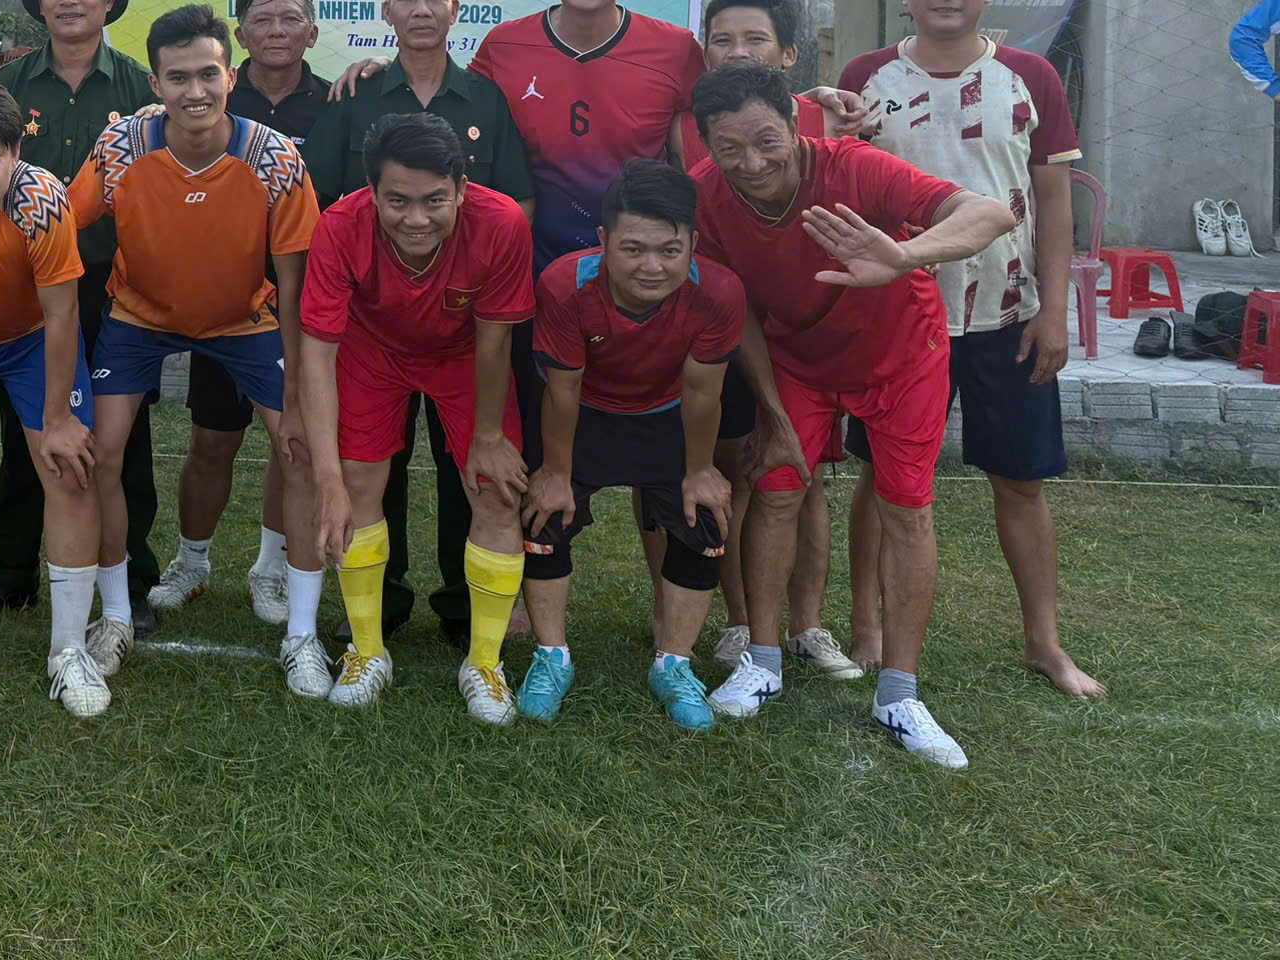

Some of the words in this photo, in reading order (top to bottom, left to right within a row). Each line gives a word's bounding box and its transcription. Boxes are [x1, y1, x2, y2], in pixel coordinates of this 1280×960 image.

[458, 4, 502, 25] 2029
[346, 33, 378, 47] Tam
[458, 37, 478, 51] 31
[570, 100, 590, 137] 6
